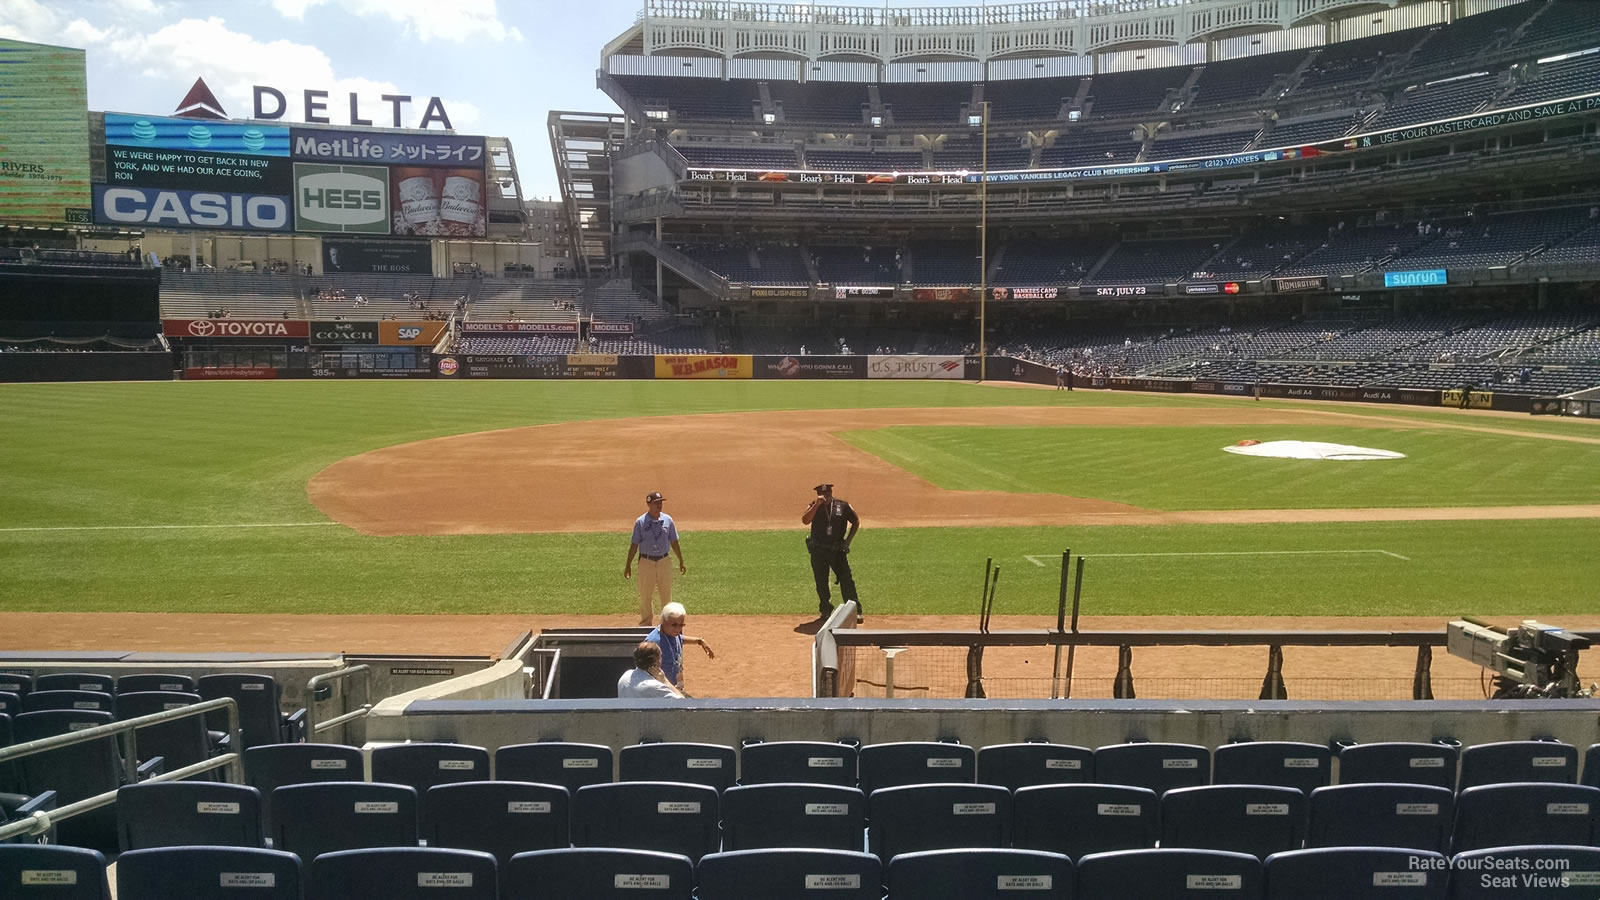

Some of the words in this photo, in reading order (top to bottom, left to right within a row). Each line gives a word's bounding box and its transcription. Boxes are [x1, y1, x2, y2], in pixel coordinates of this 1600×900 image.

[252, 85, 452, 130] DELTA
[1380, 132, 1398, 143] USE
[1400, 128, 1428, 140] YOUR
[1506, 110, 1532, 122] AND
[1534, 104, 1564, 118] SAVE
[1568, 100, 1582, 112] AT
[295, 136, 384, 159] MetLife
[390, 143, 482, 161] メットライフ
[114, 150, 127, 158] WE
[130, 152, 154, 160] WERE
[156, 154, 182, 162] HAPPY
[216, 158, 236, 166] BACK
[1204, 160, 1223, 168] (212)
[1225, 155, 1259, 166] YANKEES
[2, 162, 44, 173] RIVERS
[114, 162, 139, 171] YORK,
[142, 164, 159, 172] AND
[196, 167, 214, 175] OUR
[216, 168, 232, 176] ACE
[234, 170, 262, 179] GOING,
[1020, 172, 1052, 180] YANKEES
[1054, 170, 1081, 179] LEGACY
[1083, 169, 1102, 177] CLUB
[1103, 166, 1150, 175] MEMBERSHIP
[691, 171, 714, 180] Boar's
[726, 172, 746, 181] Head
[800, 174, 822, 182] Boar's
[834, 175, 854, 183] Head
[908, 175, 930, 184] Boar's
[942, 175, 963, 183] Head
[304, 188, 381, 210] HESS
[104, 188, 286, 228] CASIO
[1393, 272, 1437, 284] sunrun
[1116, 287, 1135, 296] JULY
[217, 322, 288, 335] TOYOTA
[398, 328, 420, 339] SAP
[872, 362, 893, 372] U.S.
[895, 362, 936, 372] TRUST
